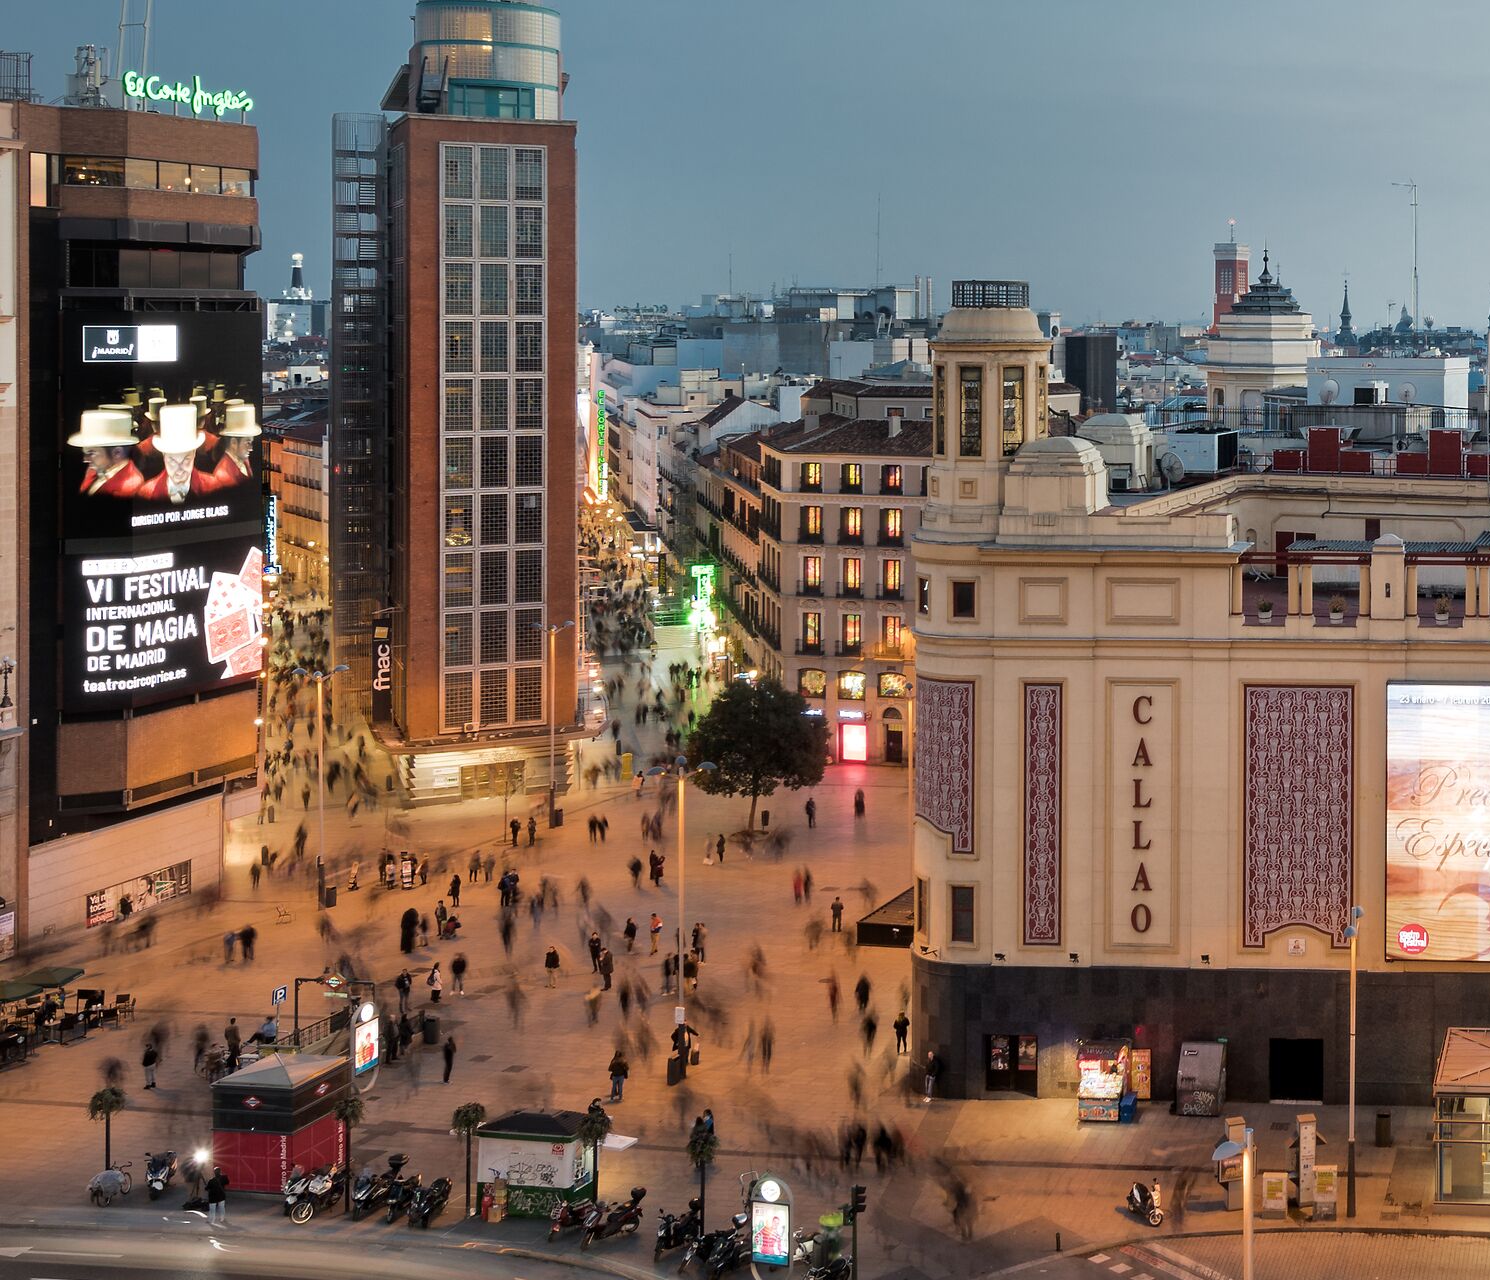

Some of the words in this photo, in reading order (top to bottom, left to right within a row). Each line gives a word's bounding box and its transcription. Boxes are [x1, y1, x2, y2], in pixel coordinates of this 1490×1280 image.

[123, 70, 145, 98] El
[145, 75, 191, 103] Corte
[191, 75, 254, 116] Inglés
[131, 512, 164, 527] DIRIGIDO
[165, 511, 180, 523] POR
[181, 508, 205, 521] JORGE
[206, 505, 228, 518] BLASS
[86, 578, 113, 603] VI
[124, 566, 209, 601] FESTIVAL
[86, 599, 176, 621] INTERNACIONAL
[86, 625, 127, 652] DE
[135, 613, 198, 648] MAGIA
[87, 655, 112, 672] DE
[116, 648, 166, 670] MADRID
[373, 644, 391, 691] fnac
[83, 668, 187, 693] teatrocircoprice.es
[1400, 695, 1410, 704] 23
[1130, 695, 1153, 933] CALLAO
[277, 988, 285, 999] P
[280, 1160, 287, 1170] de
